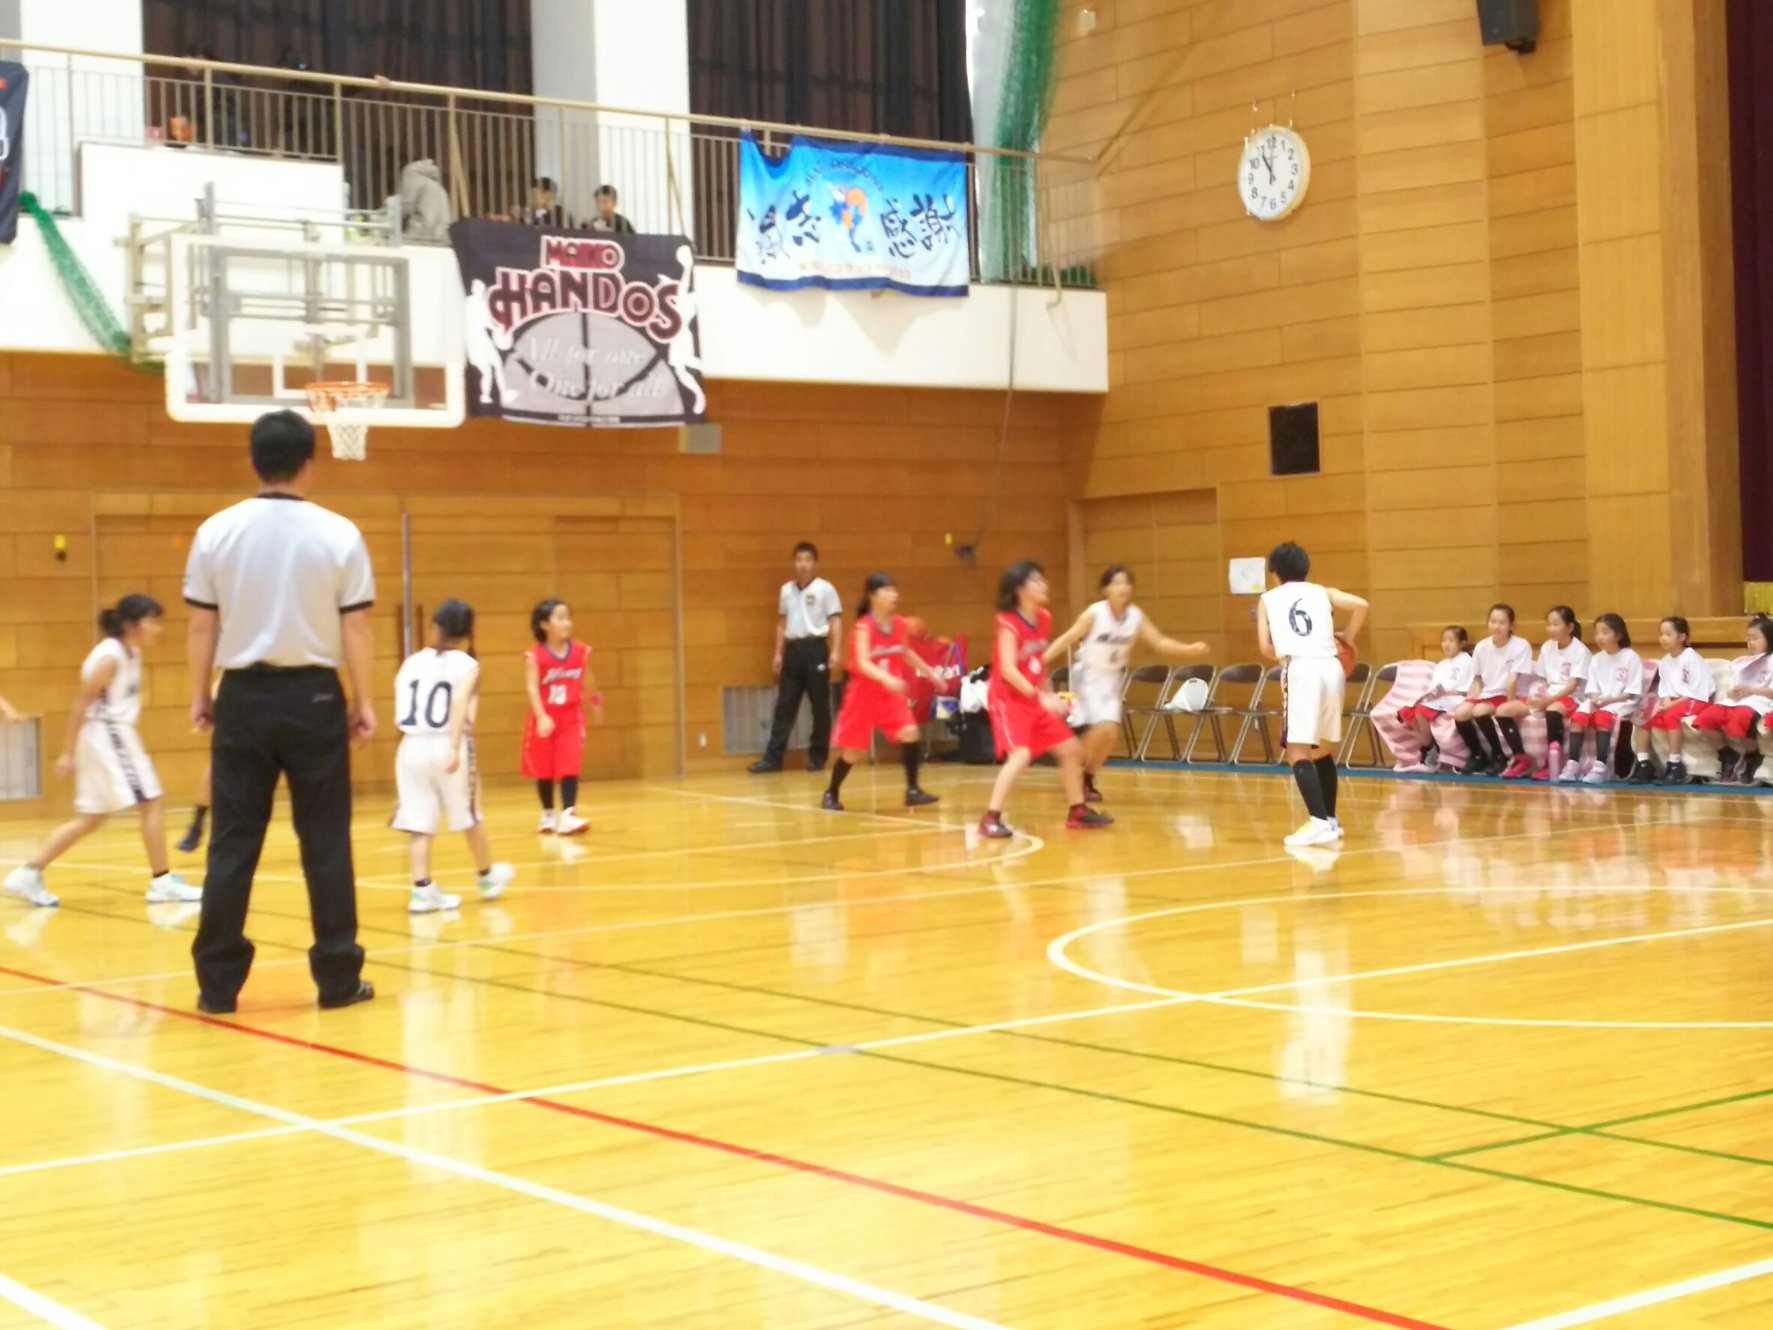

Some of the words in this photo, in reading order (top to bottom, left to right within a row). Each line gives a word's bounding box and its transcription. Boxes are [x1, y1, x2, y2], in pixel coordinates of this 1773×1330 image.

[1287, 148, 1294, 160] 2
[1249, 157, 1260, 170] 10
[1291, 163, 1298, 175] 3
[1248, 172, 1254, 185] 9
[1287, 179, 1294, 190] 4
[1251, 187, 1258, 199] 8
[1281, 191, 1287, 204] 5
[1261, 196, 1267, 207] 7
[1270, 198, 1277, 210] 6
[1288, 598, 1313, 637] 6
[401, 680, 452, 728] 10
